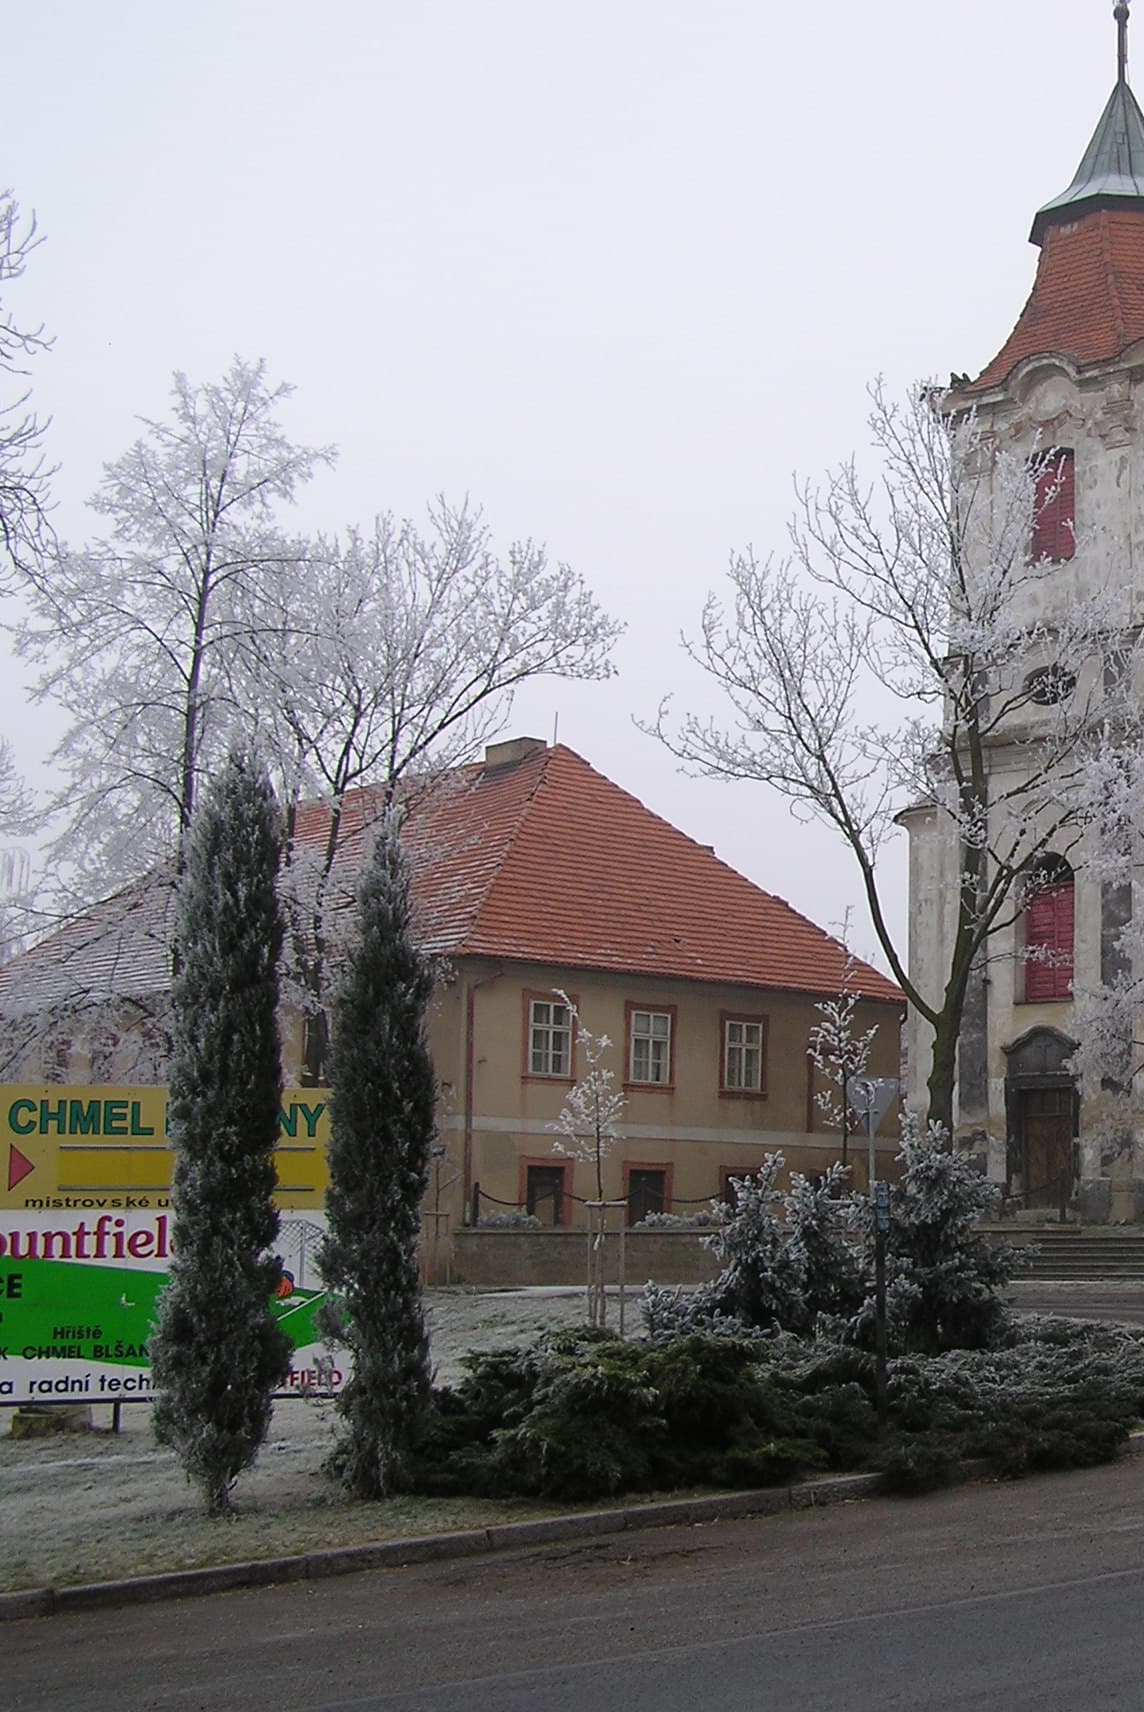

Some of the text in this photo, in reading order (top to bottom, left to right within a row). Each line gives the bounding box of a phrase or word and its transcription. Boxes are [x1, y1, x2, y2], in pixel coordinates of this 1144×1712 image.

[8, 1098, 154, 1136] CHMEL
[25, 1196, 150, 1208] mistrovské
[0, 1215, 175, 1259] untfiel
[53, 1324, 103, 1340] Hřiště
[22, 1345, 85, 1360] CHMEL
[93, 1340, 149, 1359] BLŠAN
[29, 1373, 92, 1395] radní
[99, 1374, 156, 1393] tech
